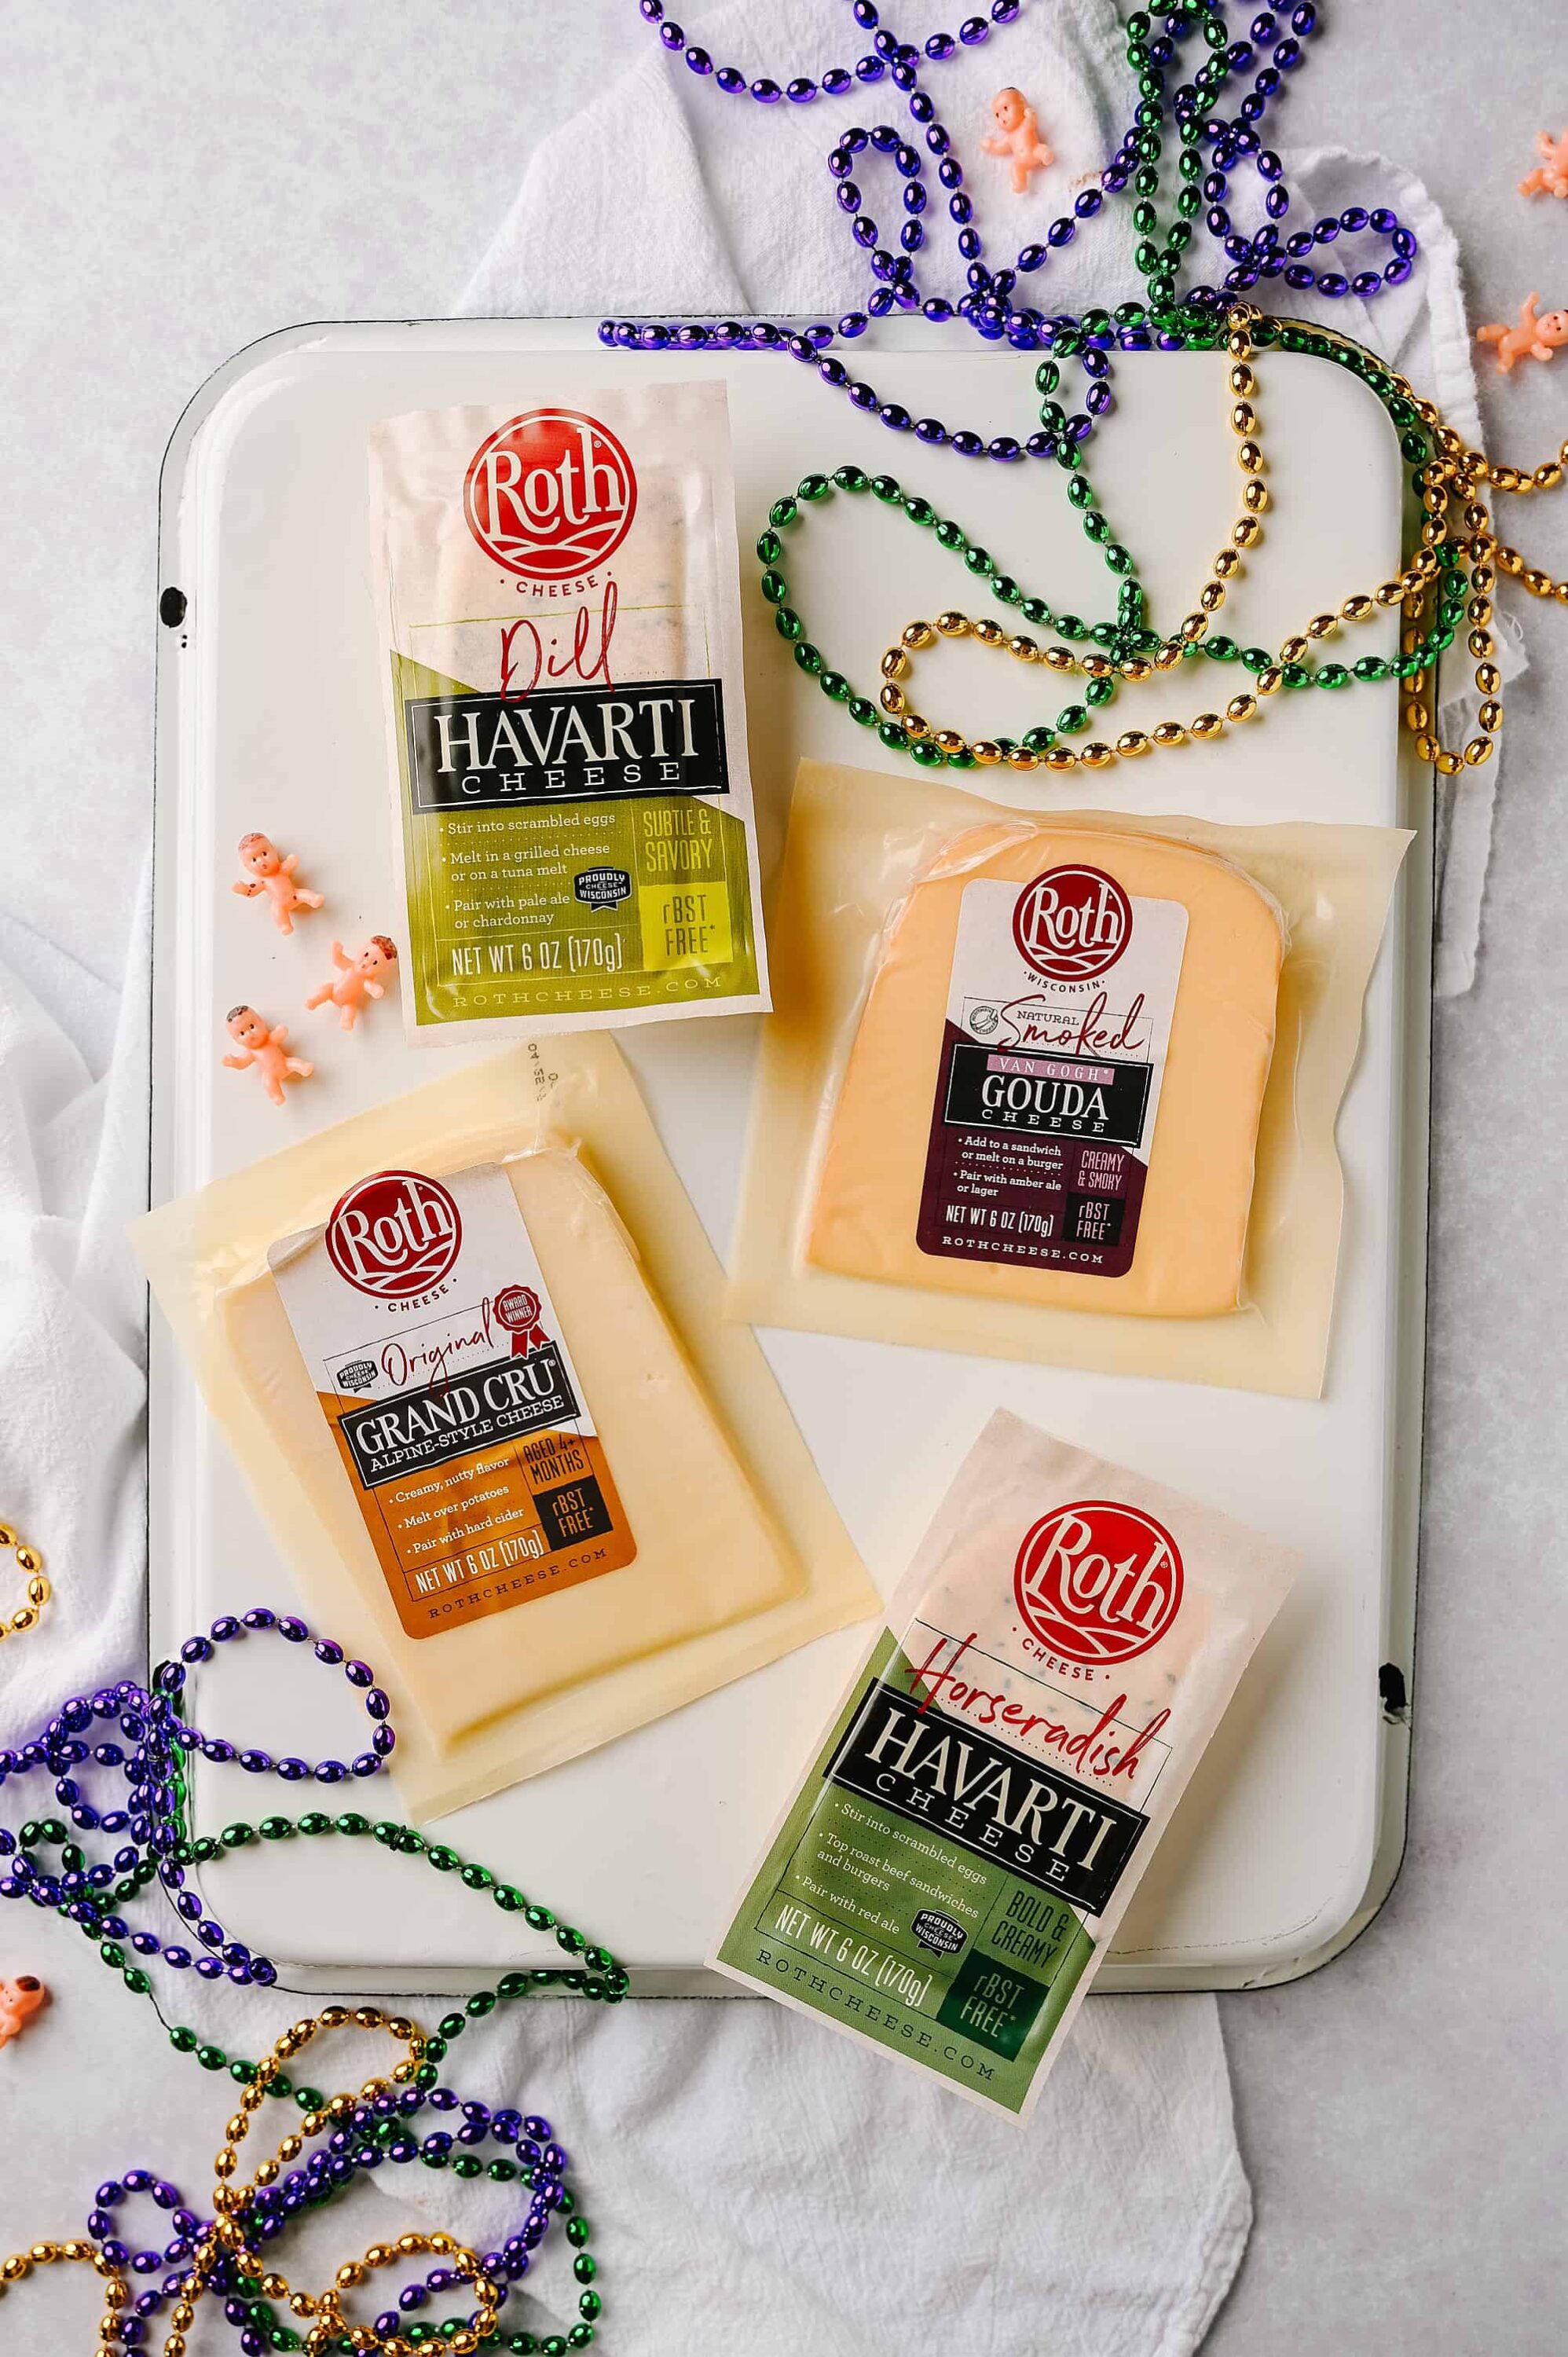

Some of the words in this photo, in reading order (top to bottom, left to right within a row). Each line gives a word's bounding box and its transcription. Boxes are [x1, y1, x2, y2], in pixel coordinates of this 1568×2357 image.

[485, 427, 625, 538] Roth
[517, 574, 598, 597] CHEESE
[500, 581, 617, 702] Dill
[434, 699, 698, 773] HAVARTI
[462, 762, 680, 794] CHEESE
[448, 823, 473, 834] Stir
[478, 822, 504, 833] into
[508, 814, 580, 830] scrambled
[584, 815, 615, 826] eggs
[643, 810, 694, 838] SUBTLE
[699, 808, 711, 835] &
[451, 852, 482, 864] Melt
[486, 851, 499, 861] in
[515, 846, 559, 863] grilled
[563, 844, 610, 856] cheese
[645, 839, 712, 872] SAVORY
[452, 872, 465, 881] or
[471, 871, 486, 880] on
[502, 867, 533, 878] tuna
[537, 863, 566, 875] melt
[579, 872, 625, 885] PROUDLY
[454, 900, 481, 911] Pair
[485, 896, 515, 909] with
[519, 893, 547, 910] pale
[551, 893, 570, 904] ale
[580, 887, 626, 900] WISCONSIN
[663, 895, 706, 924] rBST
[456, 920, 469, 929] or
[473, 914, 555, 927] chardonnay
[1025, 882, 1121, 949] Roth
[452, 946, 481, 976] NET
[489, 944, 514, 973] WT
[522, 944, 533, 971] 6
[540, 941, 562, 969] OZ
[569, 933, 622, 973] (170g)
[452, 977, 721, 1007] ROTHCHEESE.COM
[1026, 971, 1099, 993] WISCONSIN
[997, 992, 1145, 1058] Smoked
[1017, 1010, 1079, 1026] NATURAL
[999, 1058, 1035, 1073] VAN
[982, 1075, 1109, 1120] GOUDA
[982, 1109, 1105, 1132] CHEESE
[962, 1151, 973, 1160] or
[976, 1152, 999, 1162] melt
[1028, 1156, 1063, 1170] burger
[965, 1136, 987, 1148] Add
[990, 1138, 999, 1149] to
[1011, 1143, 1061, 1157] sandwich
[1082, 1150, 1125, 1172] CREAMY
[960, 1171, 981, 1180] Pair
[984, 1173, 1006, 1184] with
[1009, 1176, 1043, 1188] amber
[1046, 1180, 1061, 1190] ale
[971, 1183, 998, 1197] lager
[1078, 1171, 1085, 1186] &
[1089, 1171, 1122, 1191] SMOKY
[946, 1205, 966, 1223] NET
[970, 1208, 987, 1226] WT
[990, 1211, 997, 1227] 6
[1001, 1212, 1016, 1230] OZ
[1018, 1211, 1054, 1237] (170g)
[1079, 1202, 1110, 1221] rBST
[339, 1179, 453, 1277] Roth
[943, 1236, 1103, 1263] ROTHCHEESE.COM
[388, 1284, 449, 1312] CHEESE
[503, 1295, 528, 1310] AWARD
[505, 1306, 533, 1322] WINNER
[382, 1297, 494, 1396] Original
[339, 1362, 372, 1379] PROUDLY
[342, 1370, 376, 1387] WISCONSIN
[356, 1387, 481, 1454] GRAND
[371, 1419, 493, 1472] ALPINE-STYLE
[496, 1395, 564, 1429] CHEESE
[522, 1437, 555, 1464] AGED
[559, 1434, 576, 1450] 4+
[395, 1481, 443, 1503] Creamy,
[445, 1468, 474, 1487] nutty
[476, 1457, 509, 1475] flavor
[530, 1450, 584, 1485] MONTHS
[404, 1511, 431, 1529] Melt
[434, 1504, 458, 1519] over
[462, 1486, 509, 1510] potatoes
[552, 1488, 585, 1516] rBST
[412, 1538, 436, 1554] Pair
[439, 1530, 464, 1544] with
[466, 1516, 493, 1534] hard
[495, 1508, 524, 1524] cider
[415, 1567, 441, 1593] NET
[442, 1559, 464, 1584] WT
[467, 1555, 478, 1574] 6
[479, 1548, 499, 1571] OZ
[500, 1530, 544, 1567] (170g)
[1024, 1513, 1166, 1633] Roth
[429, 1548, 606, 1618] ROTHCHEESE.COM
[1021, 1637, 1094, 1681] CHEESE
[904, 1633, 1171, 1780] Horseradish
[864, 1706, 1117, 1871] HAVARTI
[876, 1772, 1071, 1882] CHEESE
[841, 1803, 865, 1822] Stir
[866, 1816, 890, 1835] into
[892, 1830, 958, 1868] scrambled
[958, 1864, 987, 1885] eggs
[817, 1849, 840, 1867] and
[842, 1859, 891, 1892] burgers
[826, 1833, 848, 1853] Top
[850, 1847, 881, 1868] roast
[881, 1858, 911, 1881] beef
[910, 1878, 979, 1918] sandwiches
[803, 1876, 829, 1897] Pair
[830, 1892, 855, 1913] with
[858, 1907, 881, 1924] red
[881, 1918, 900, 1934] ale
[1006, 1890, 1054, 1932] BOLD
[1051, 1914, 1069, 1942] &
[916, 1923, 958, 1951] WISCONSIN
[921, 1914, 963, 1938] PROUDLY
[775, 1904, 811, 1940] NET
[809, 1922, 839, 1953] WT
[835, 1937, 852, 1962] 6
[852, 1945, 880, 1976] OZ
[875, 1955, 932, 2007] (170g)
[991, 1920, 1057, 1967] CREAMY
[974, 1973, 1024, 2009] rBST
[757, 1949, 995, 2080] ROTHCHEESE.COM
